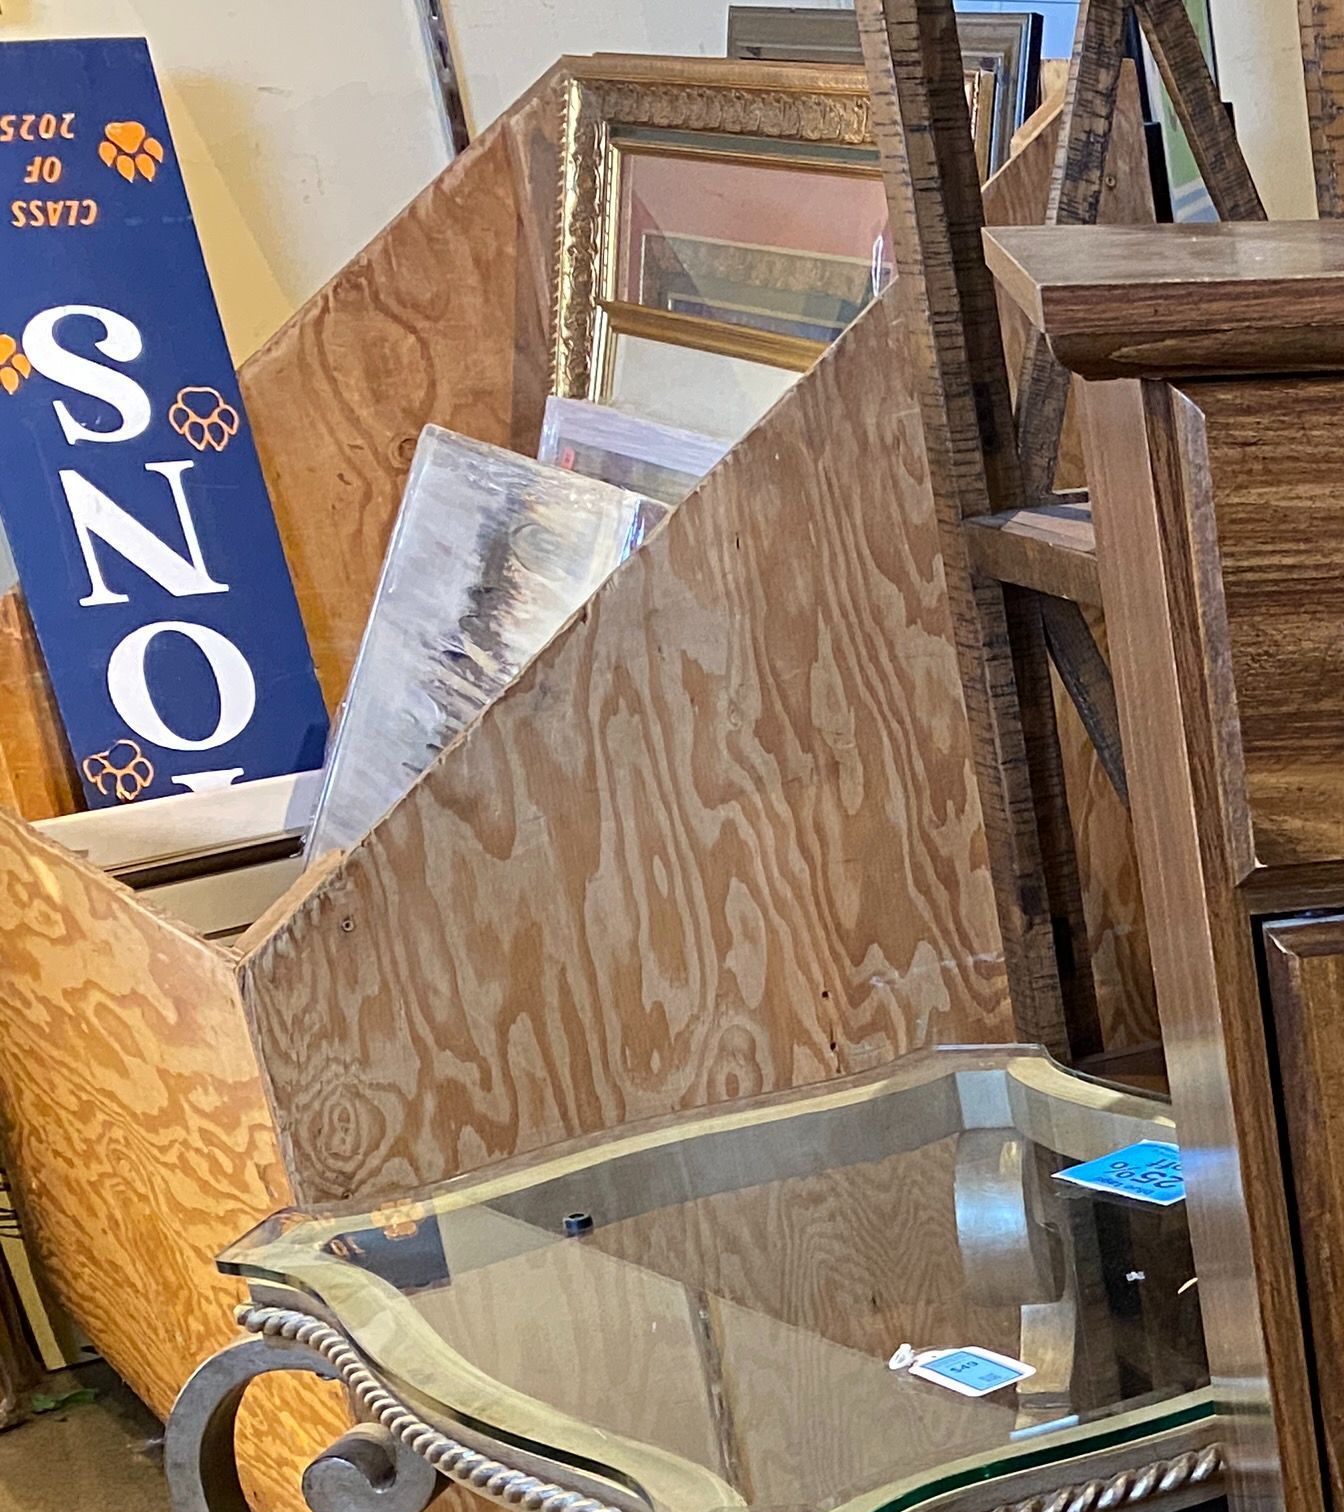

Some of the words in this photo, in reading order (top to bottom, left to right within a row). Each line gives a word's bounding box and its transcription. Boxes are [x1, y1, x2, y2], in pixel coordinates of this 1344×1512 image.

[0, 112, 76, 142] 2025
[24, 155, 62, 184] OF
[11, 199, 98, 228] CLASS
[1103, 1160, 1184, 1189] 25%
